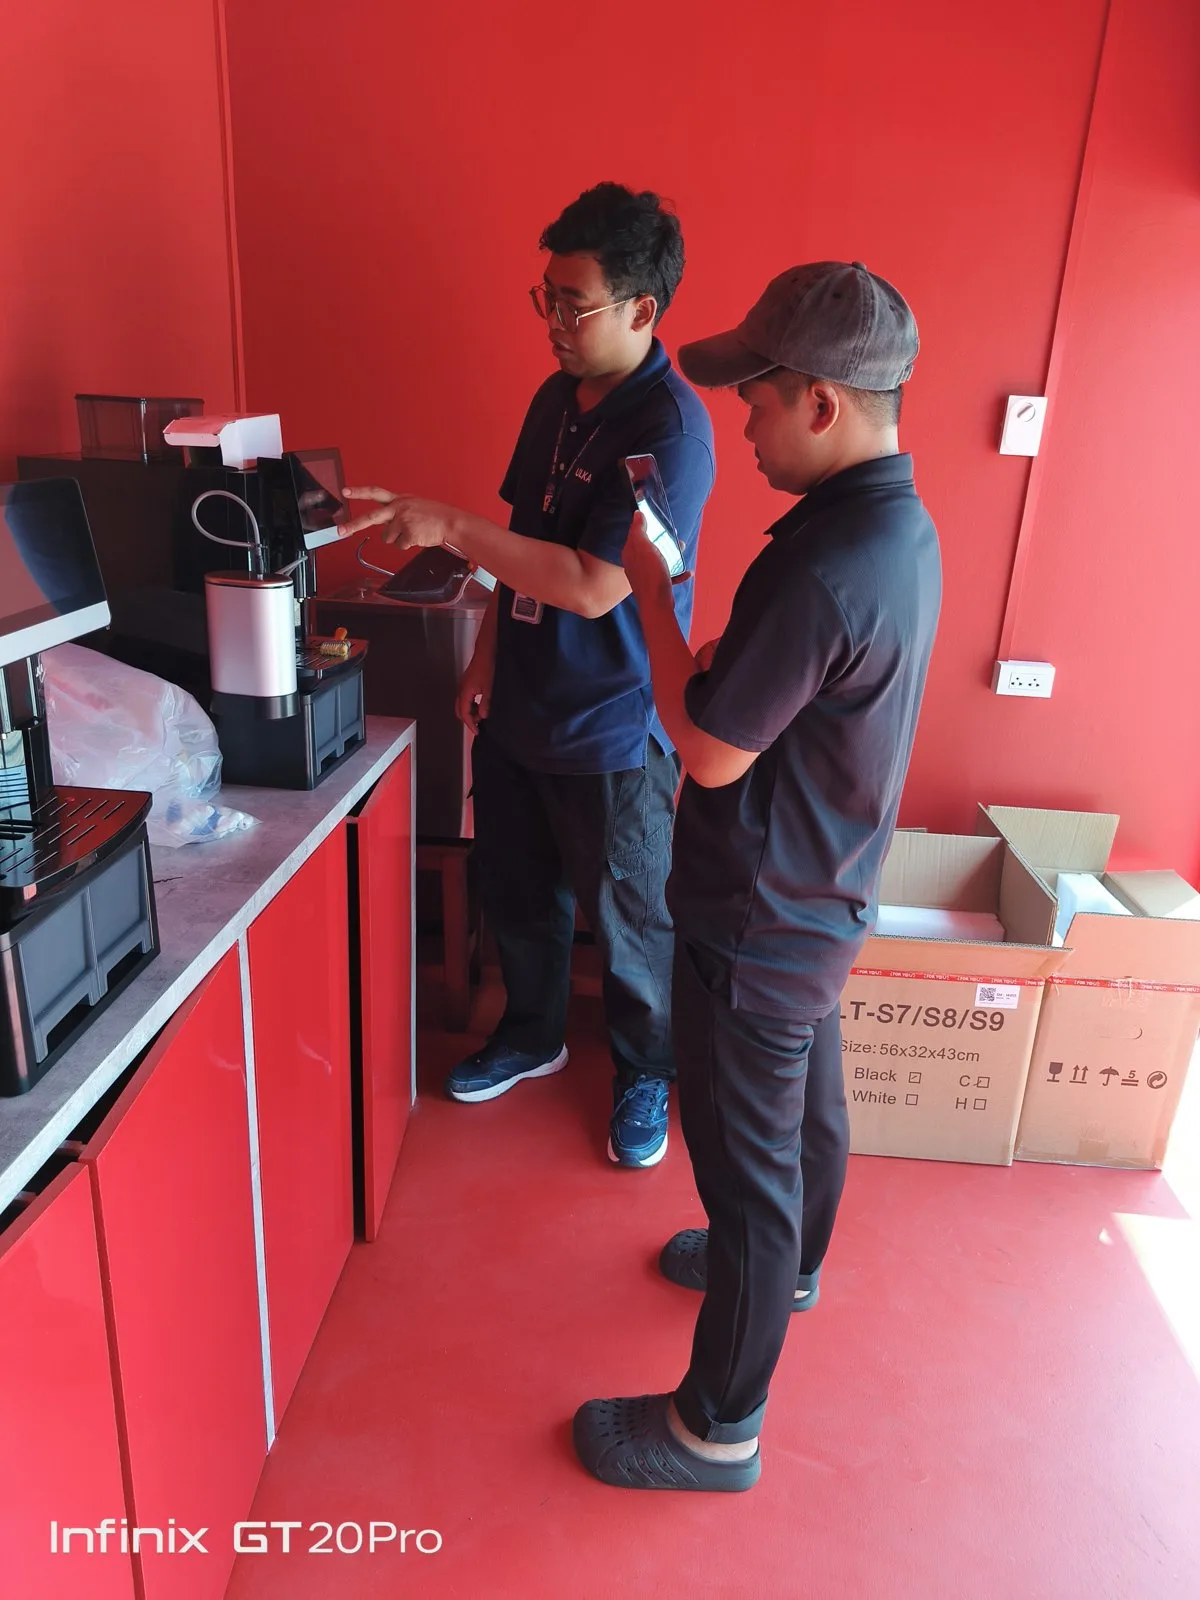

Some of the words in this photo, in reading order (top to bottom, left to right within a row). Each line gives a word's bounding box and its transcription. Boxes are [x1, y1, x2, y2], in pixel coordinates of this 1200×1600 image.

[840, 1001, 1005, 1031] T-S7/S8/S9
[880, 1043, 980, 1062] 56x32x43cm
[854, 1067, 897, 1082] Black
[959, 1075, 971, 1087] C
[1128, 1070, 1136, 1079] 5
[852, 1090, 897, 1105] White
[955, 1097, 967, 1110] H
